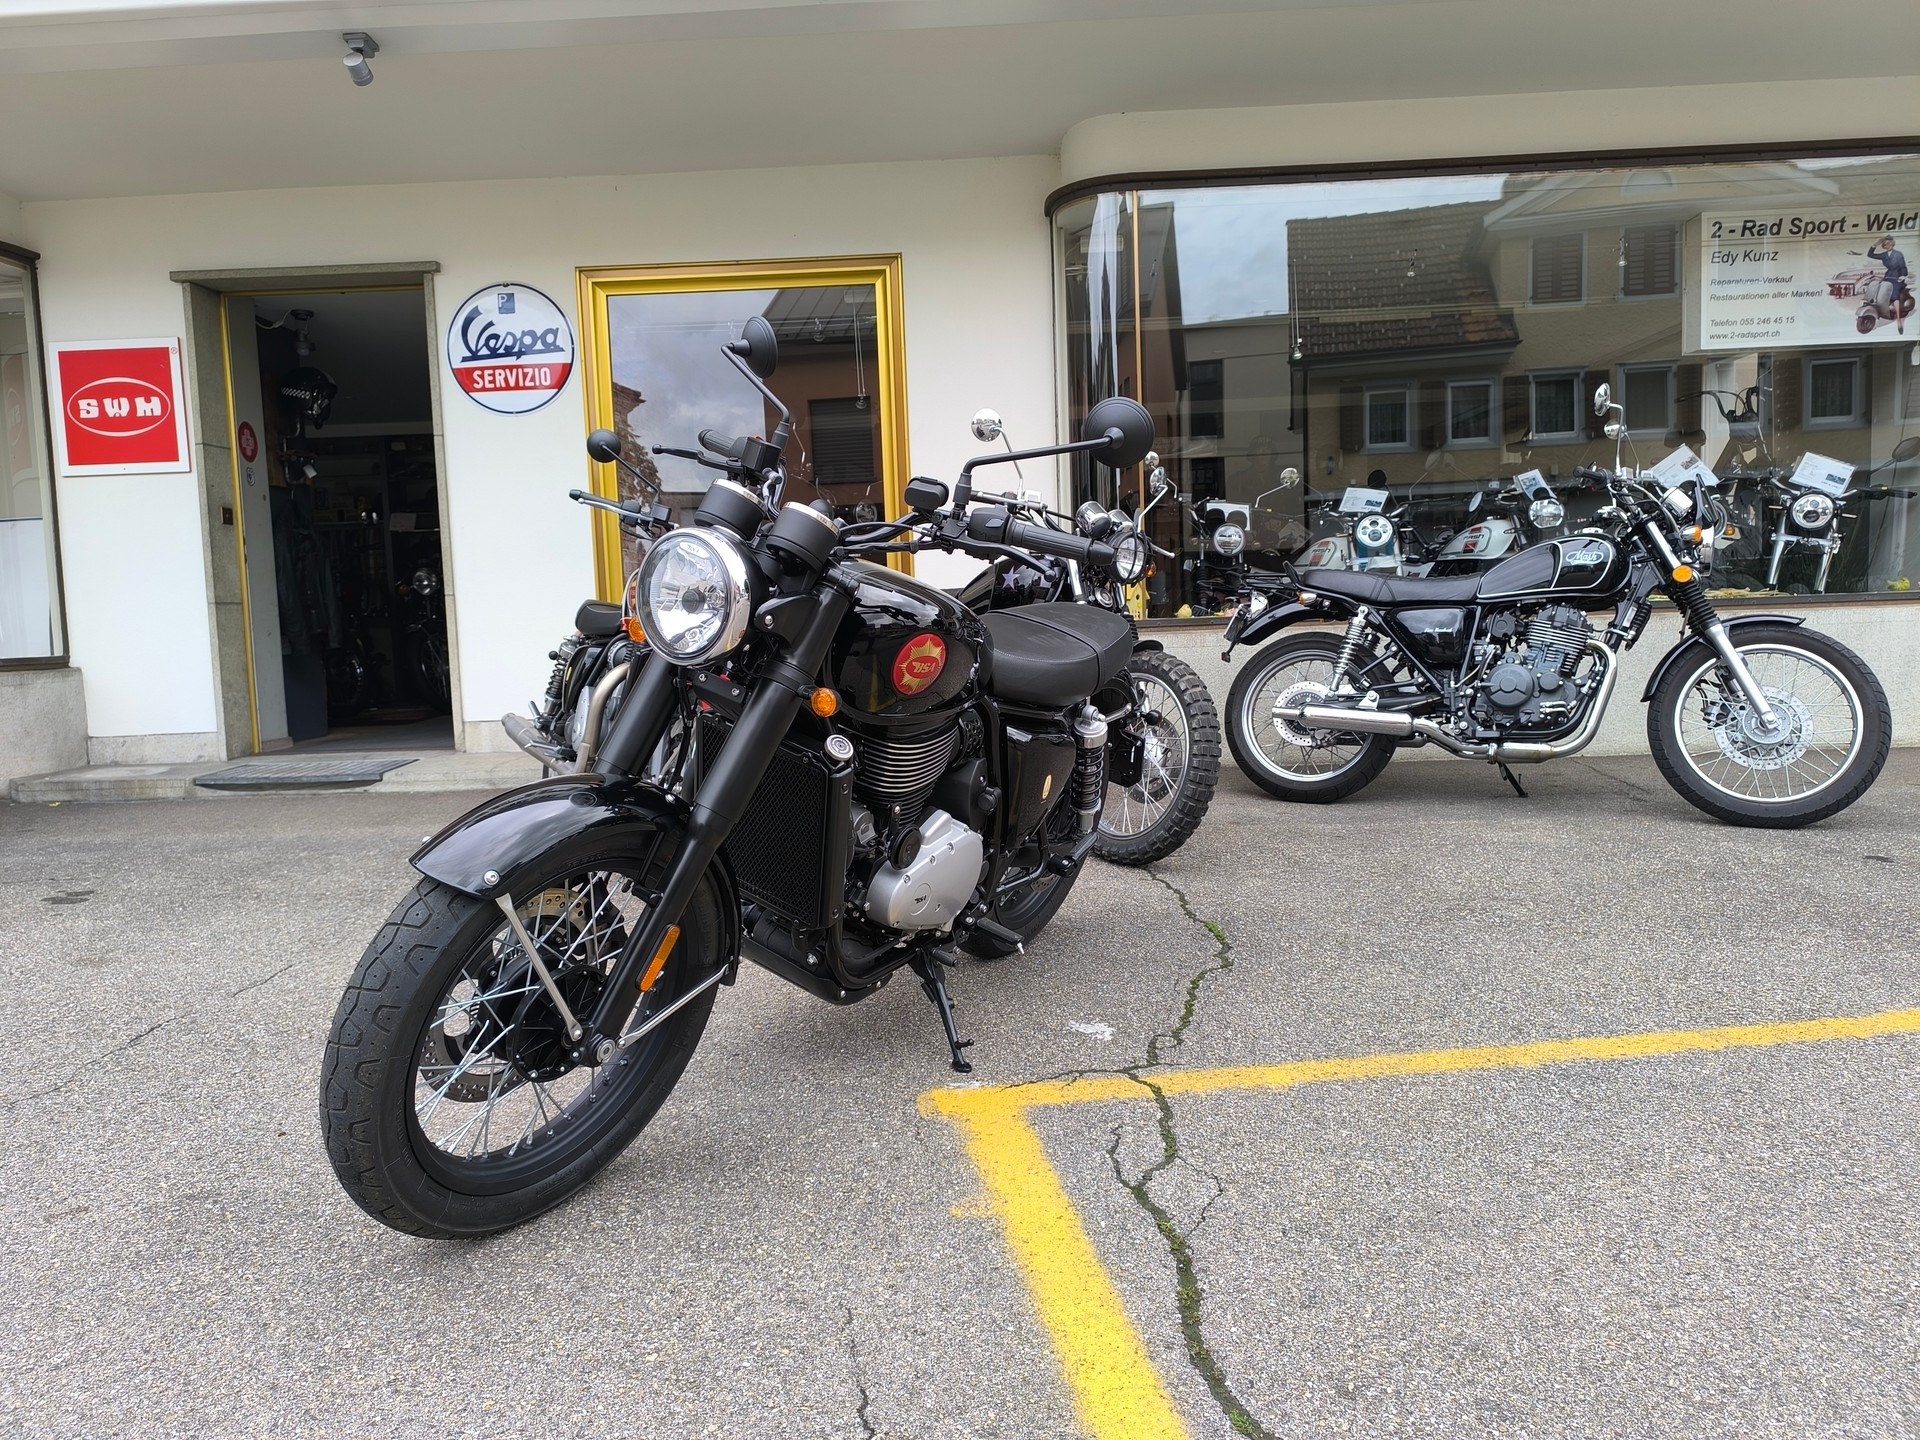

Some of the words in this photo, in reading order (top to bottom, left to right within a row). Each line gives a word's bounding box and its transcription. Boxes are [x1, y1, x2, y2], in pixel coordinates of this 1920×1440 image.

[1711, 221, 1723, 238] 2
[1741, 218, 1783, 237] Rad
[1789, 216, 1847, 239] Sport
[1867, 212, 1918, 231] Wald
[1711, 251, 1739, 266] Edy
[1743, 249, 1779, 262] Kunz
[1710, 275, 1793, 287] Reparaturen-Verkauf
[1710, 292, 1769, 301] Restaurationen
[1771, 291, 1789, 299] aller
[1791, 290, 1823, 298] Marken!
[1710, 319, 1738, 328] Telefon
[1740, 318, 1755, 326] 055
[1757, 317, 1771, 325] 246
[1773, 316, 1783, 324] 45
[1786, 316, 1795, 324] 15
[460, 305, 565, 362] Vespa
[1710, 330, 1781, 340] www.2-radsport.ch
[473, 367, 551, 389] SERVIZIO
[77, 396, 162, 419] SWM
[912, 661, 936, 673] BSA
